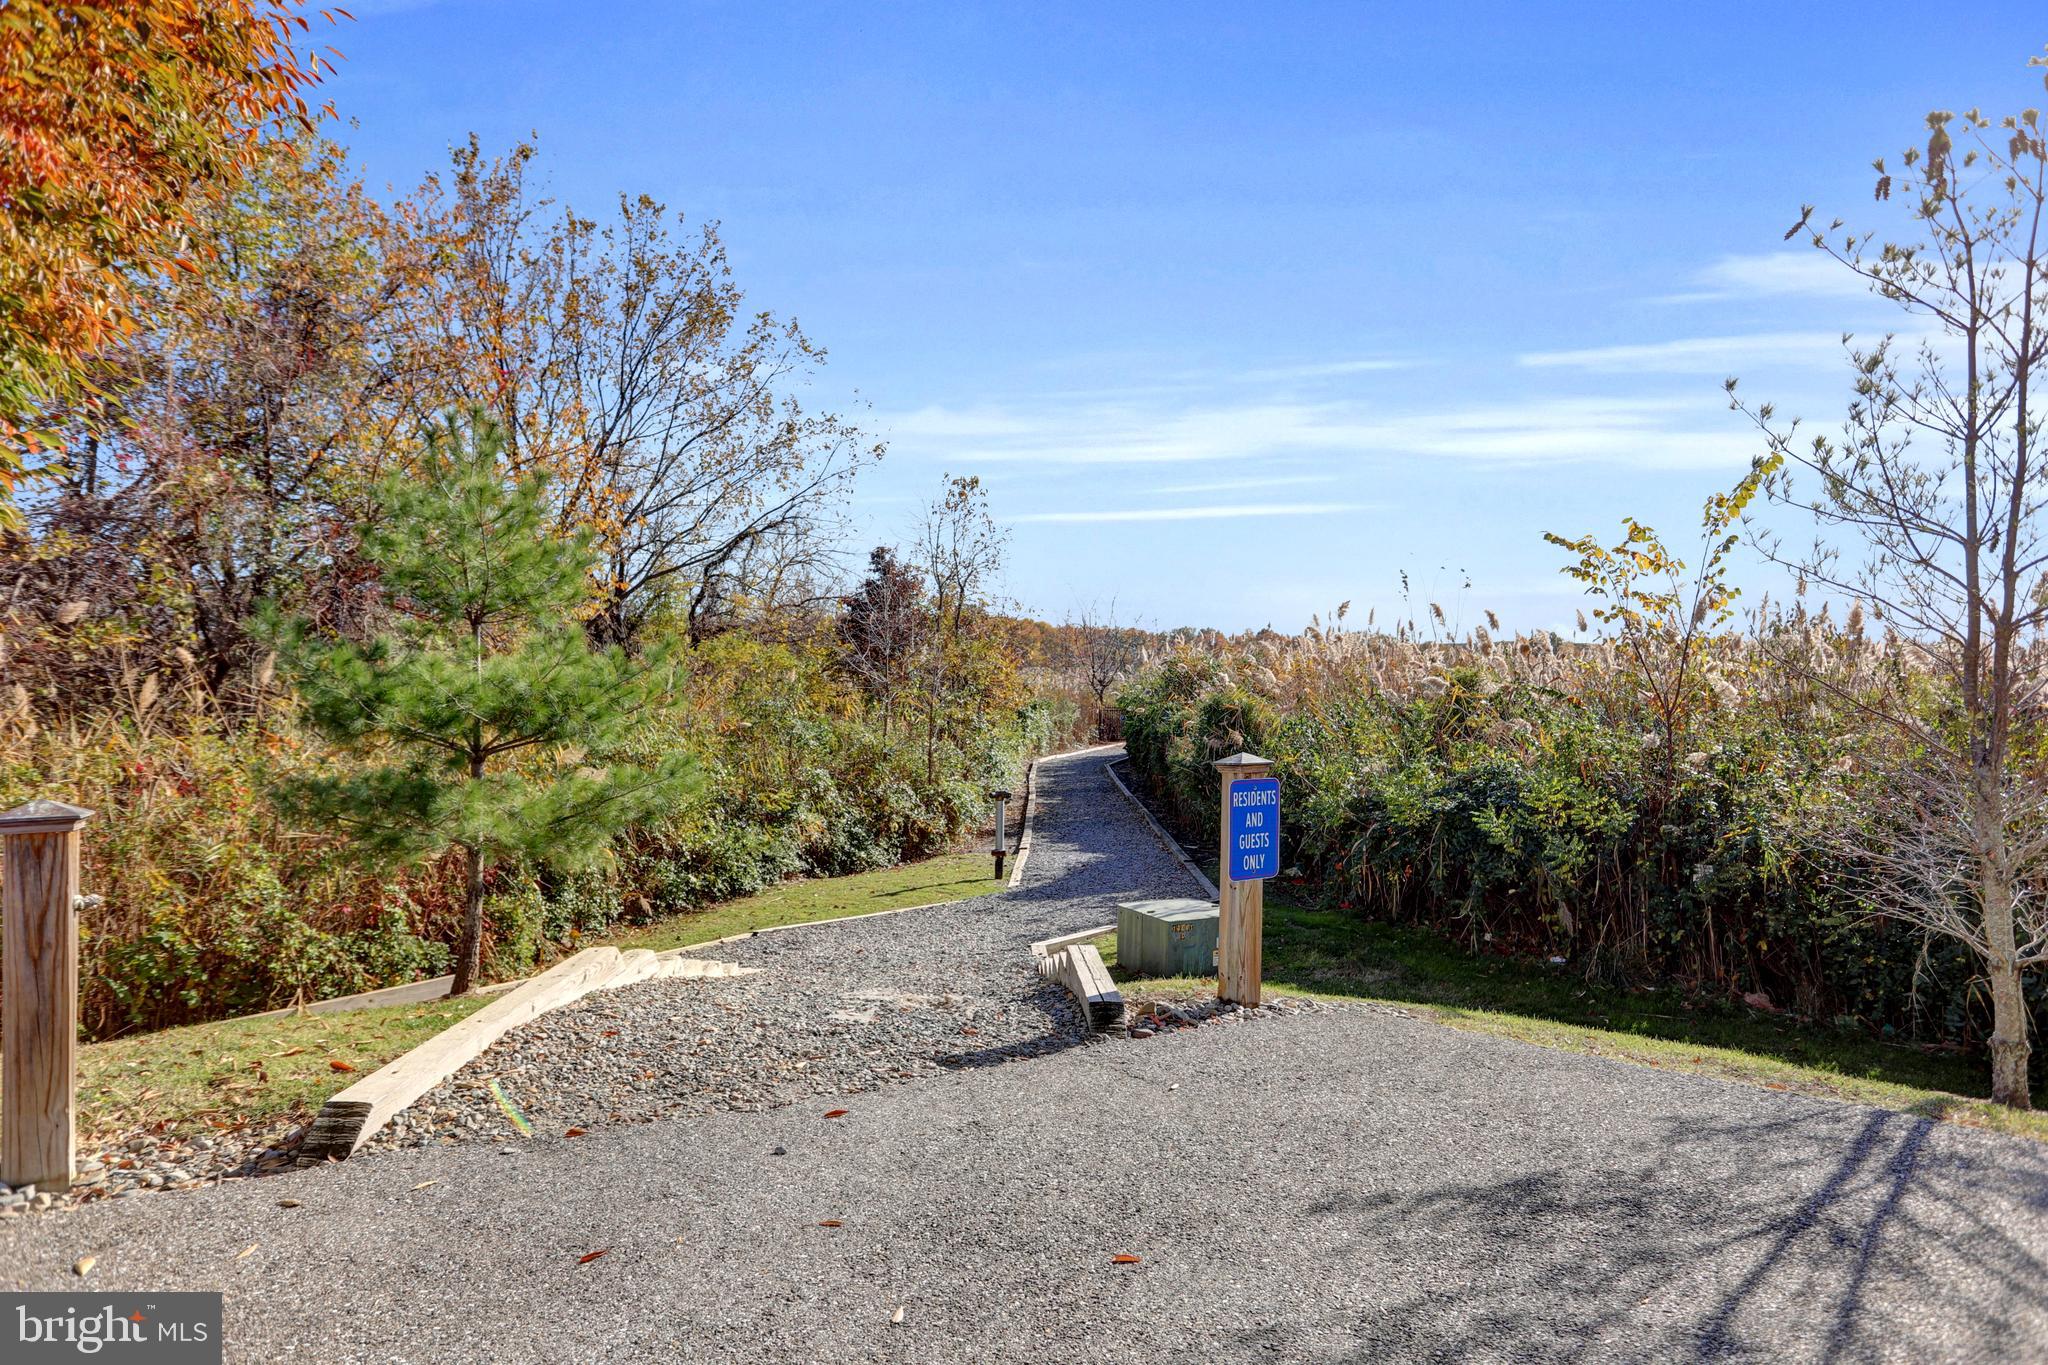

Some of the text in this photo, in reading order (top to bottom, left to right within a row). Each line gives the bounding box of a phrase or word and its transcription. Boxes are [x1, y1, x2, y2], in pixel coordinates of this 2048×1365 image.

[1233, 790, 1276, 807] RESIDENTS
[1245, 812, 1264, 828] AND
[1239, 832, 1269, 849] GUESTS
[1243, 854, 1265, 870] ONLY
